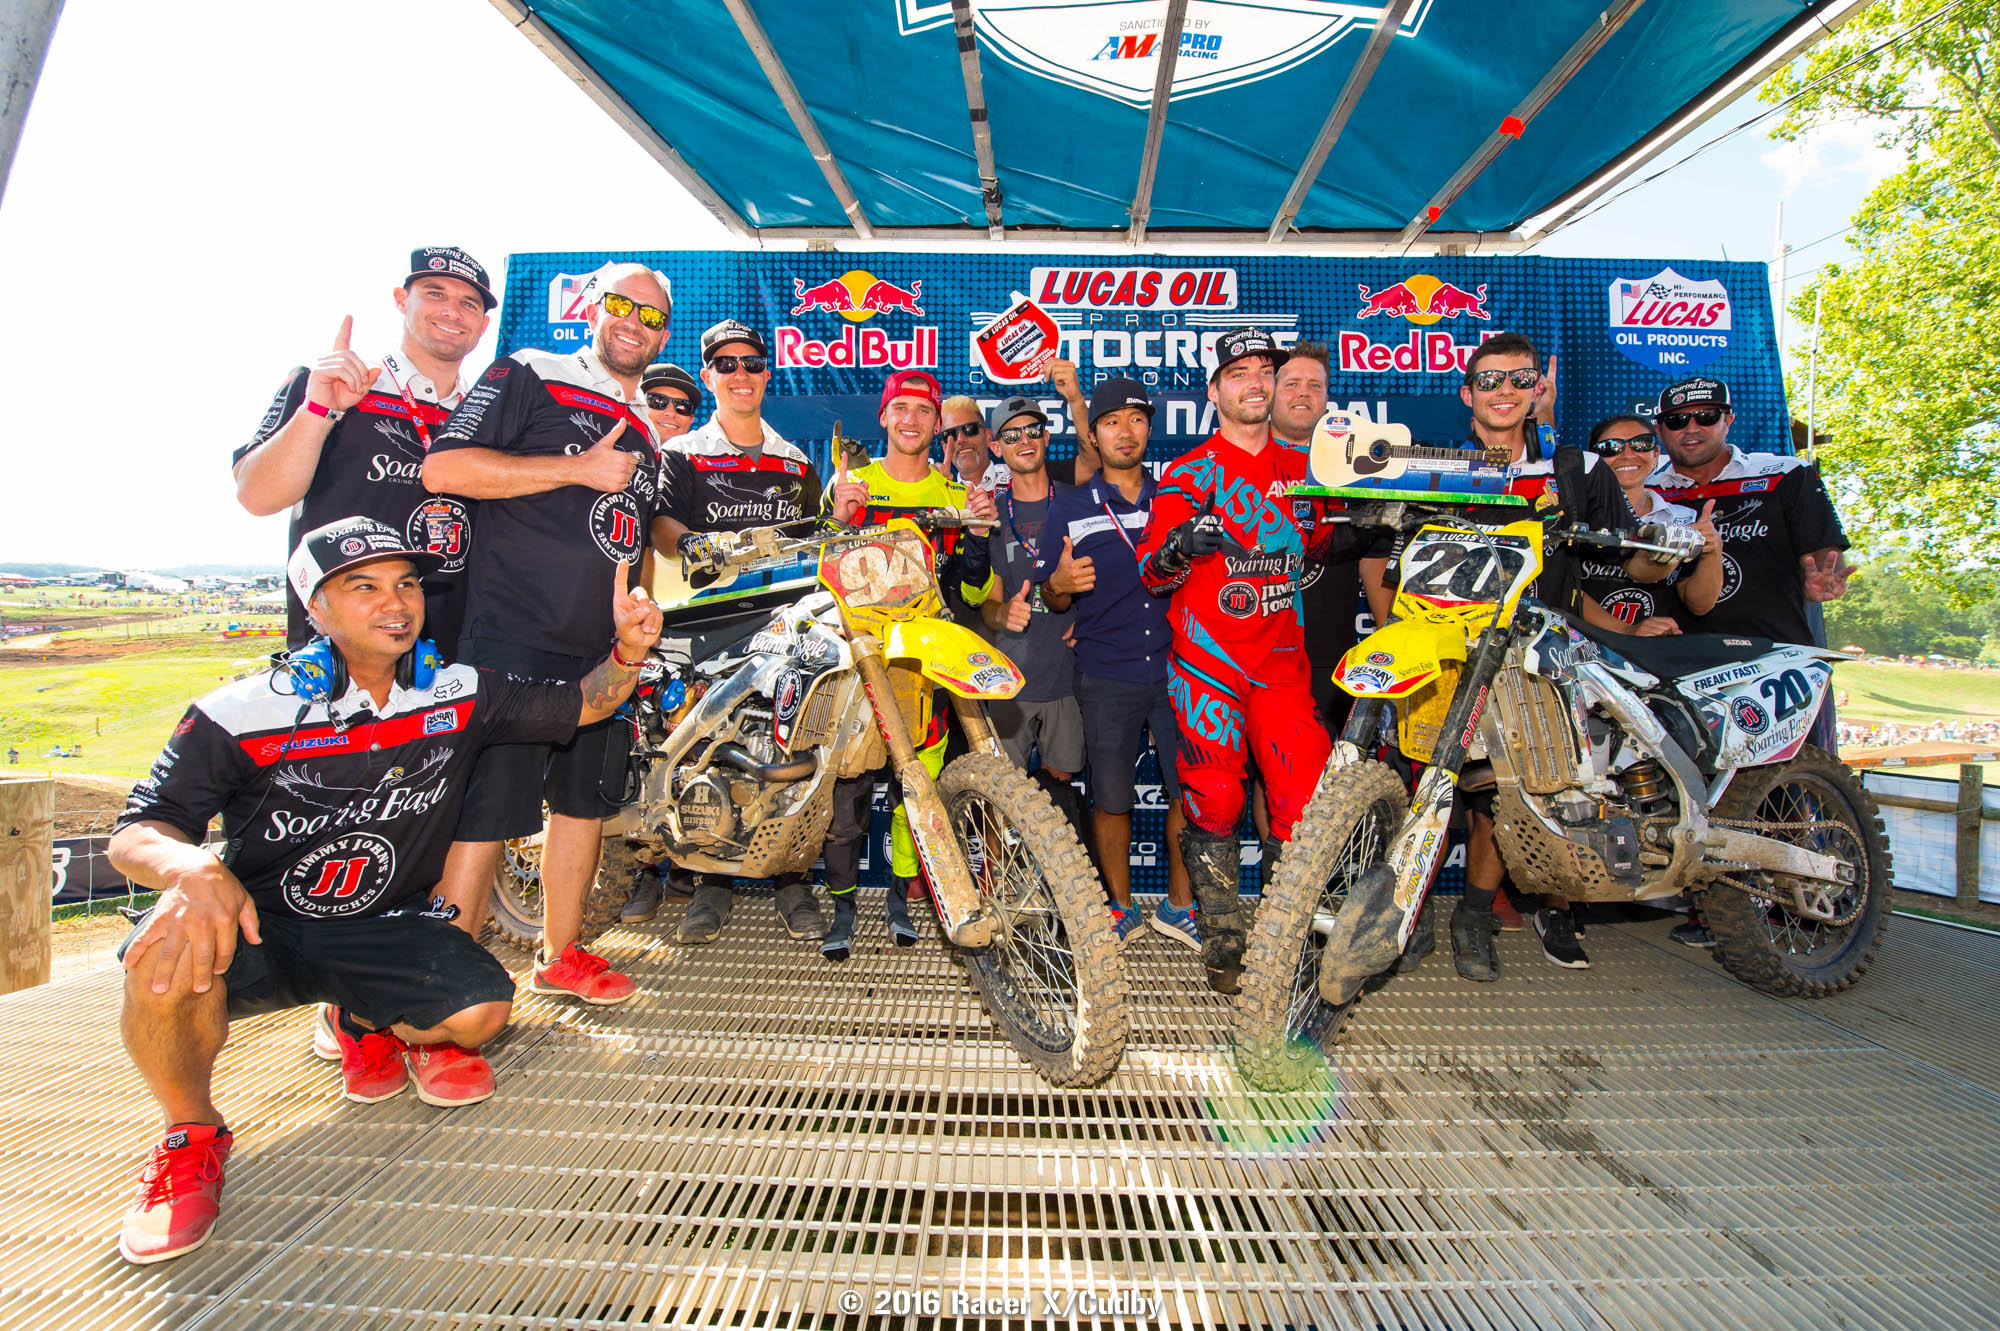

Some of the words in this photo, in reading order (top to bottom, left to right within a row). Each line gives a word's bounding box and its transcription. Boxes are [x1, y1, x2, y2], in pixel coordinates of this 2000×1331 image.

[1195, 19, 1211, 29] BY
[1180, 32, 1222, 50] PRO
[1177, 49, 1219, 60] RACING
[424, 247, 461, 260] Soaring
[1038, 270, 1164, 306] LUCAS
[1168, 270, 1230, 306] OIL
[991, 317, 1009, 335] LUCAS
[1009, 310, 1019, 322] OIL
[1090, 313, 1177, 326] PRO
[1622, 301, 1726, 328] LUCAS
[553, 328, 579, 340] OIL
[1000, 331, 1019, 347] LUCAS
[1019, 323, 1029, 335] OIL
[1225, 330, 1252, 347] Soaring
[1254, 330, 1269, 339] Eagle
[1615, 333, 1643, 346] OIL
[1647, 334, 1728, 348] PRODUCTS
[776, 326, 856, 369] Red
[860, 326, 938, 368] Bull
[1339, 329, 1422, 373] Red
[1658, 352, 1690, 365] INC.
[1668, 381, 1698, 397] Soaring
[1698, 379, 1718, 389] Eagle
[595, 491, 624, 522] JIMMY
[706, 500, 772, 523] Soaring
[1170, 457, 1282, 545] ANSR
[325, 523, 375, 544] Soaring
[610, 509, 635, 547] JJ
[1718, 519, 1769, 542] Eagle
[838, 540, 930, 609] 94
[1224, 555, 1282, 578] Soaring
[1402, 542, 1525, 603] 20
[1230, 594, 1246, 609] JJ
[1694, 670, 1731, 691] FREAKY
[1733, 664, 1760, 679] FAST!
[1760, 669, 1813, 722] 20
[1167, 673, 1245, 752] ANSR
[1741, 706, 1758, 726] JJ
[280, 736, 350, 752] SUZUKI
[1746, 724, 1790, 762] Soaring
[293, 838, 349, 878] JIMMY
[352, 838, 388, 874] JOHN'S
[308, 857, 370, 898] JJ
[290, 884, 376, 914] SANDWICHES
